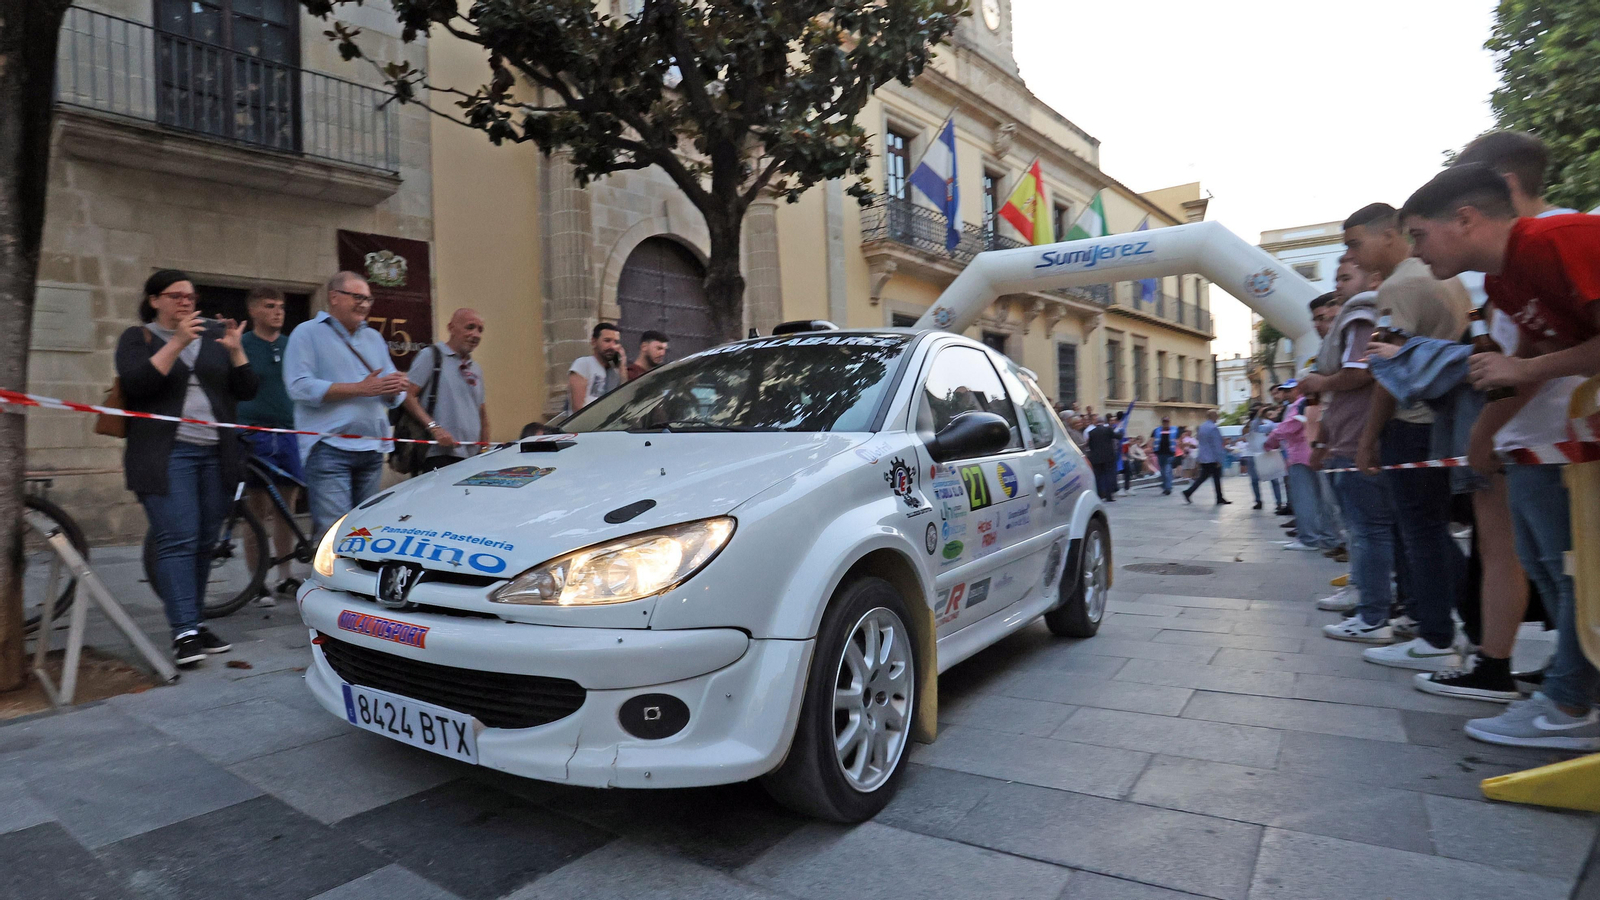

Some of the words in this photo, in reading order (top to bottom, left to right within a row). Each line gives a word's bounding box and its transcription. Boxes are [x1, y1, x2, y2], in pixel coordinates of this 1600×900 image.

[961, 466, 987, 508] 27
[358, 694, 414, 739] 8424
[419, 711, 471, 757] BTX
